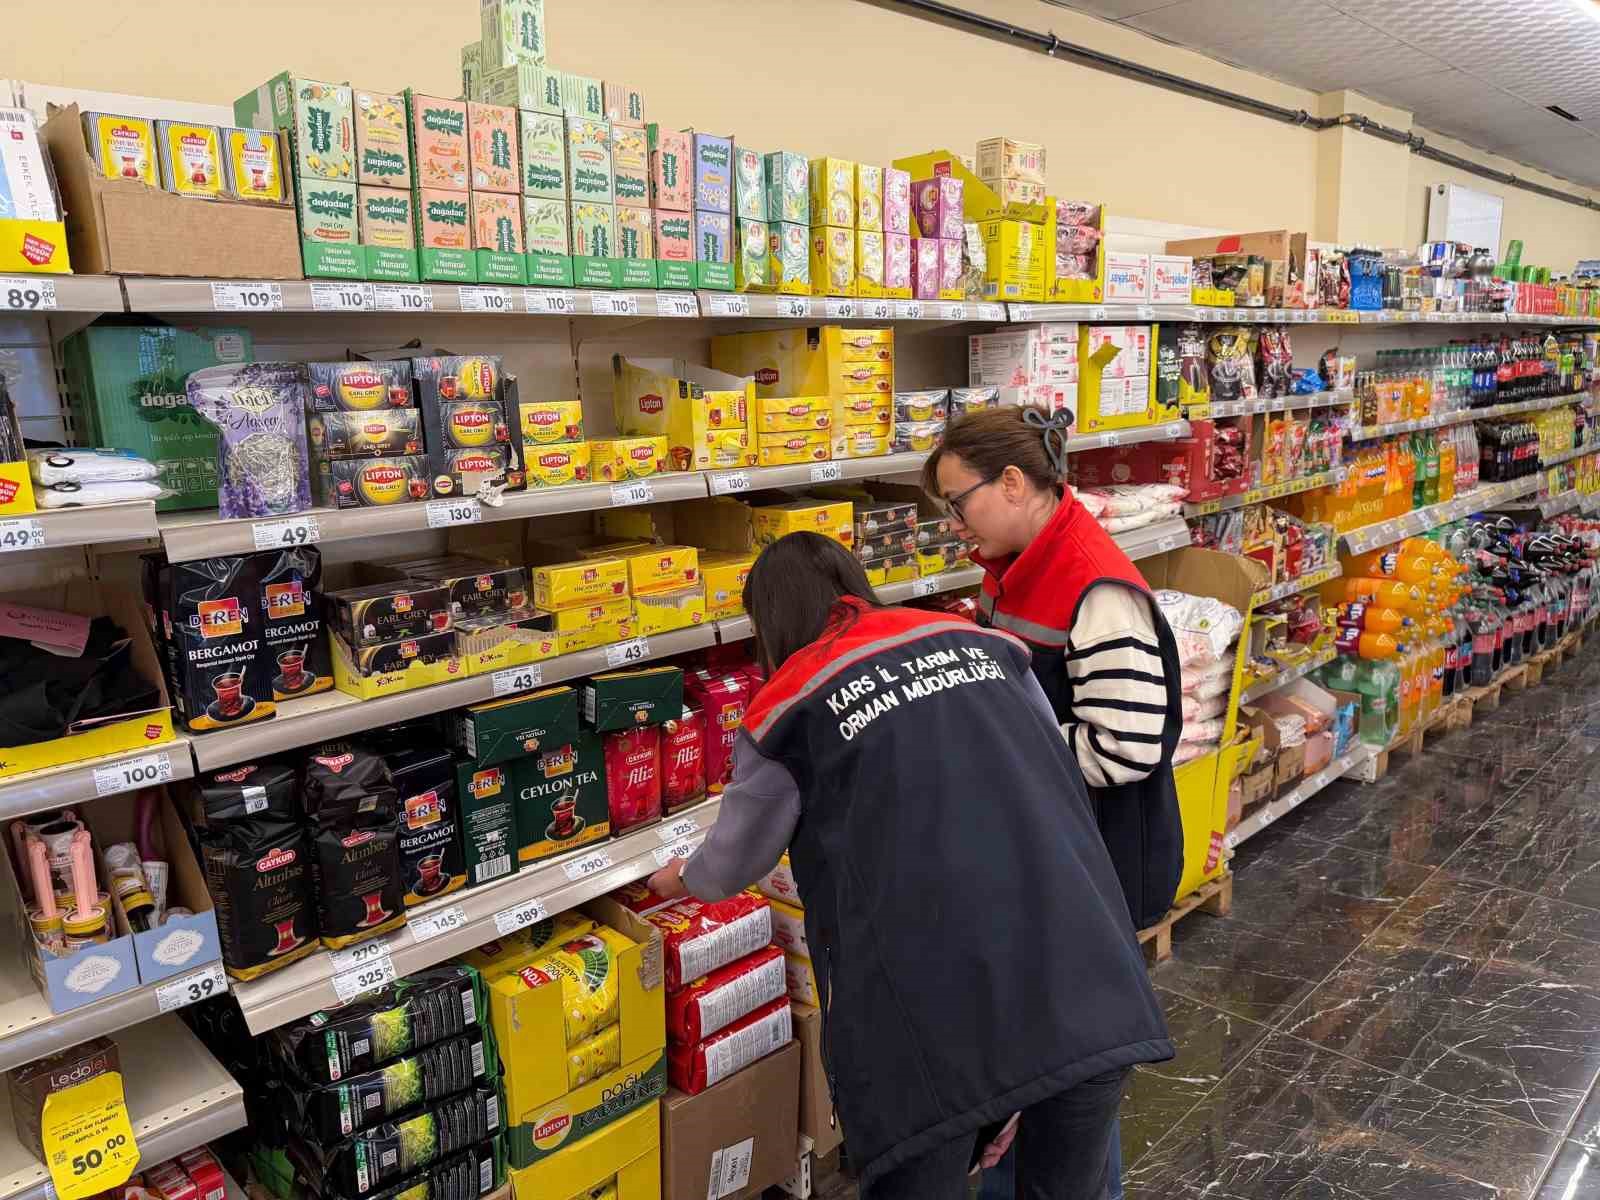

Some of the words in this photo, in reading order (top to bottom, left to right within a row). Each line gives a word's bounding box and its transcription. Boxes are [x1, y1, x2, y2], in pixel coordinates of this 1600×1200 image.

[343, 375, 382, 385] LIPTON
[454, 414, 489, 424] LIPTON
[529, 413, 560, 422] LIPTON
[460, 459, 493, 470] LIPTON
[541, 455, 569, 465] LIPTON
[365, 469, 402, 481] LIPTON
[261, 591, 312, 609] DEREN
[189, 607, 249, 627] DEREN
[265, 619, 320, 639] ERGAMOT
[188, 639, 260, 661] BERGAMOT
[625, 645, 642, 660] 43
[513, 675, 533, 690] 43
[826, 674, 877, 715] KARS
[875, 664, 899, 684] İL
[901, 649, 960, 675] TARIM
[962, 647, 991, 660] VE
[839, 691, 900, 741] ORMAN
[901, 660, 1006, 702] MÜDÜRLÜĞÜ
[537, 751, 578, 769] DEREN
[674, 746, 701, 769] filiz
[123, 765, 157, 784] 100
[625, 766, 655, 791] filiz
[520, 776, 573, 801] CEYLON
[575, 770, 598, 787] TEA
[399, 798, 447, 823] DEREN
[400, 824, 455, 849] BERGAMOT
[258, 851, 294, 871] ÇAYKUR
[433, 914, 457, 930] 145
[516, 908, 538, 924] 389
[358, 968, 384, 987] 325
[188, 978, 214, 1000] 39
[537, 1118, 567, 1136] Lipton
